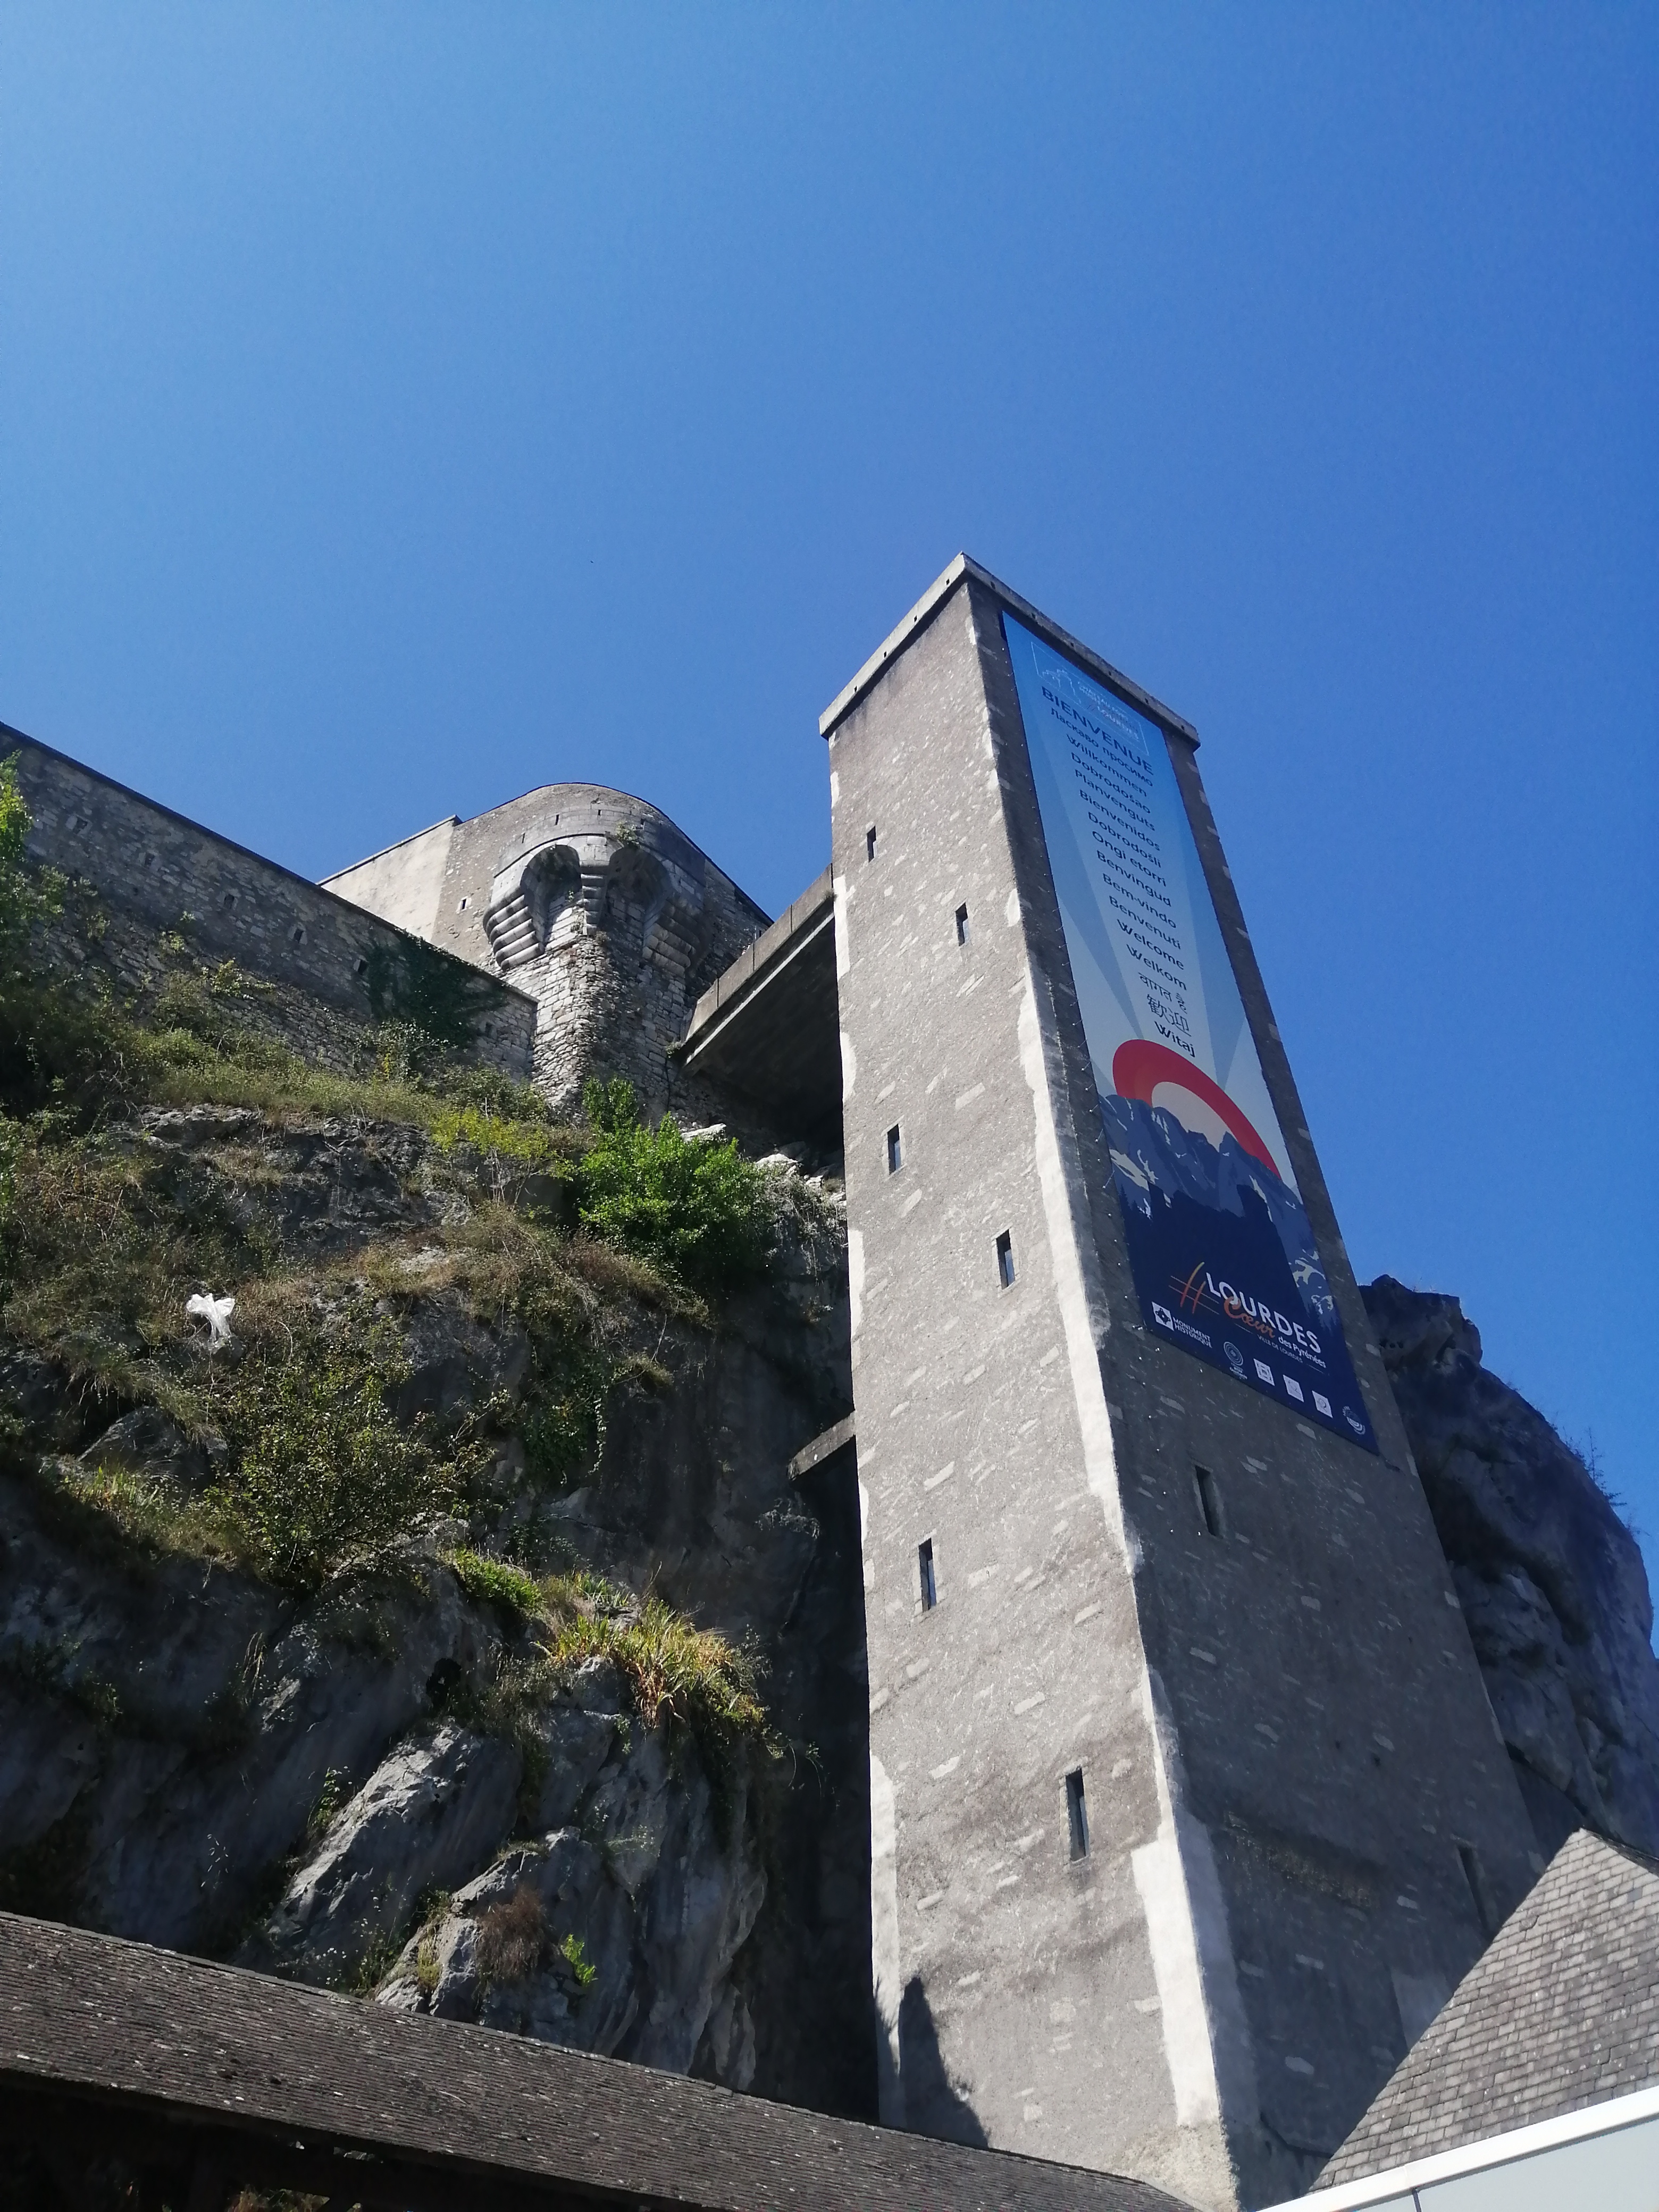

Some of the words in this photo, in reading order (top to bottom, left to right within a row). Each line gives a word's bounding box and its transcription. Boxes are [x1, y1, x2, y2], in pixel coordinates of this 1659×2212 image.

[1042, 686, 1154, 775] BIENVENUE
[1051, 708, 1099, 747] Ласкаво
[1103, 747, 1153, 786] просимо
[1067, 734, 1146, 797] Willkommen
[1071, 752, 1151, 814] Dobrodošao
[1075, 769, 1155, 831] Planvenguts
[1079, 790, 1160, 851] Bienvenidos
[1088, 812, 1161, 868] Dobrodošli
[1092, 831, 1126, 859] Ongi
[1130, 858, 1166, 887] etorri
[1097, 850, 1171, 907] Benvingud
[1103, 873, 1176, 928] Bem-vindo
[1109, 895, 1180, 950] Benvenuti
[1117, 919, 1184, 970] Welcome
[1126, 944, 1187, 991] Welkom
[1154, 1021, 1195, 1058] Witaj
[1172, 1317, 1211, 1342] MONUMENT
[1174, 1322, 1212, 1348] HISTORIQUE
[1206, 1272, 1321, 1353] LOURDES
[1278, 1336, 1292, 1349] des
[1292, 1343, 1326, 1368] Pyrénées
